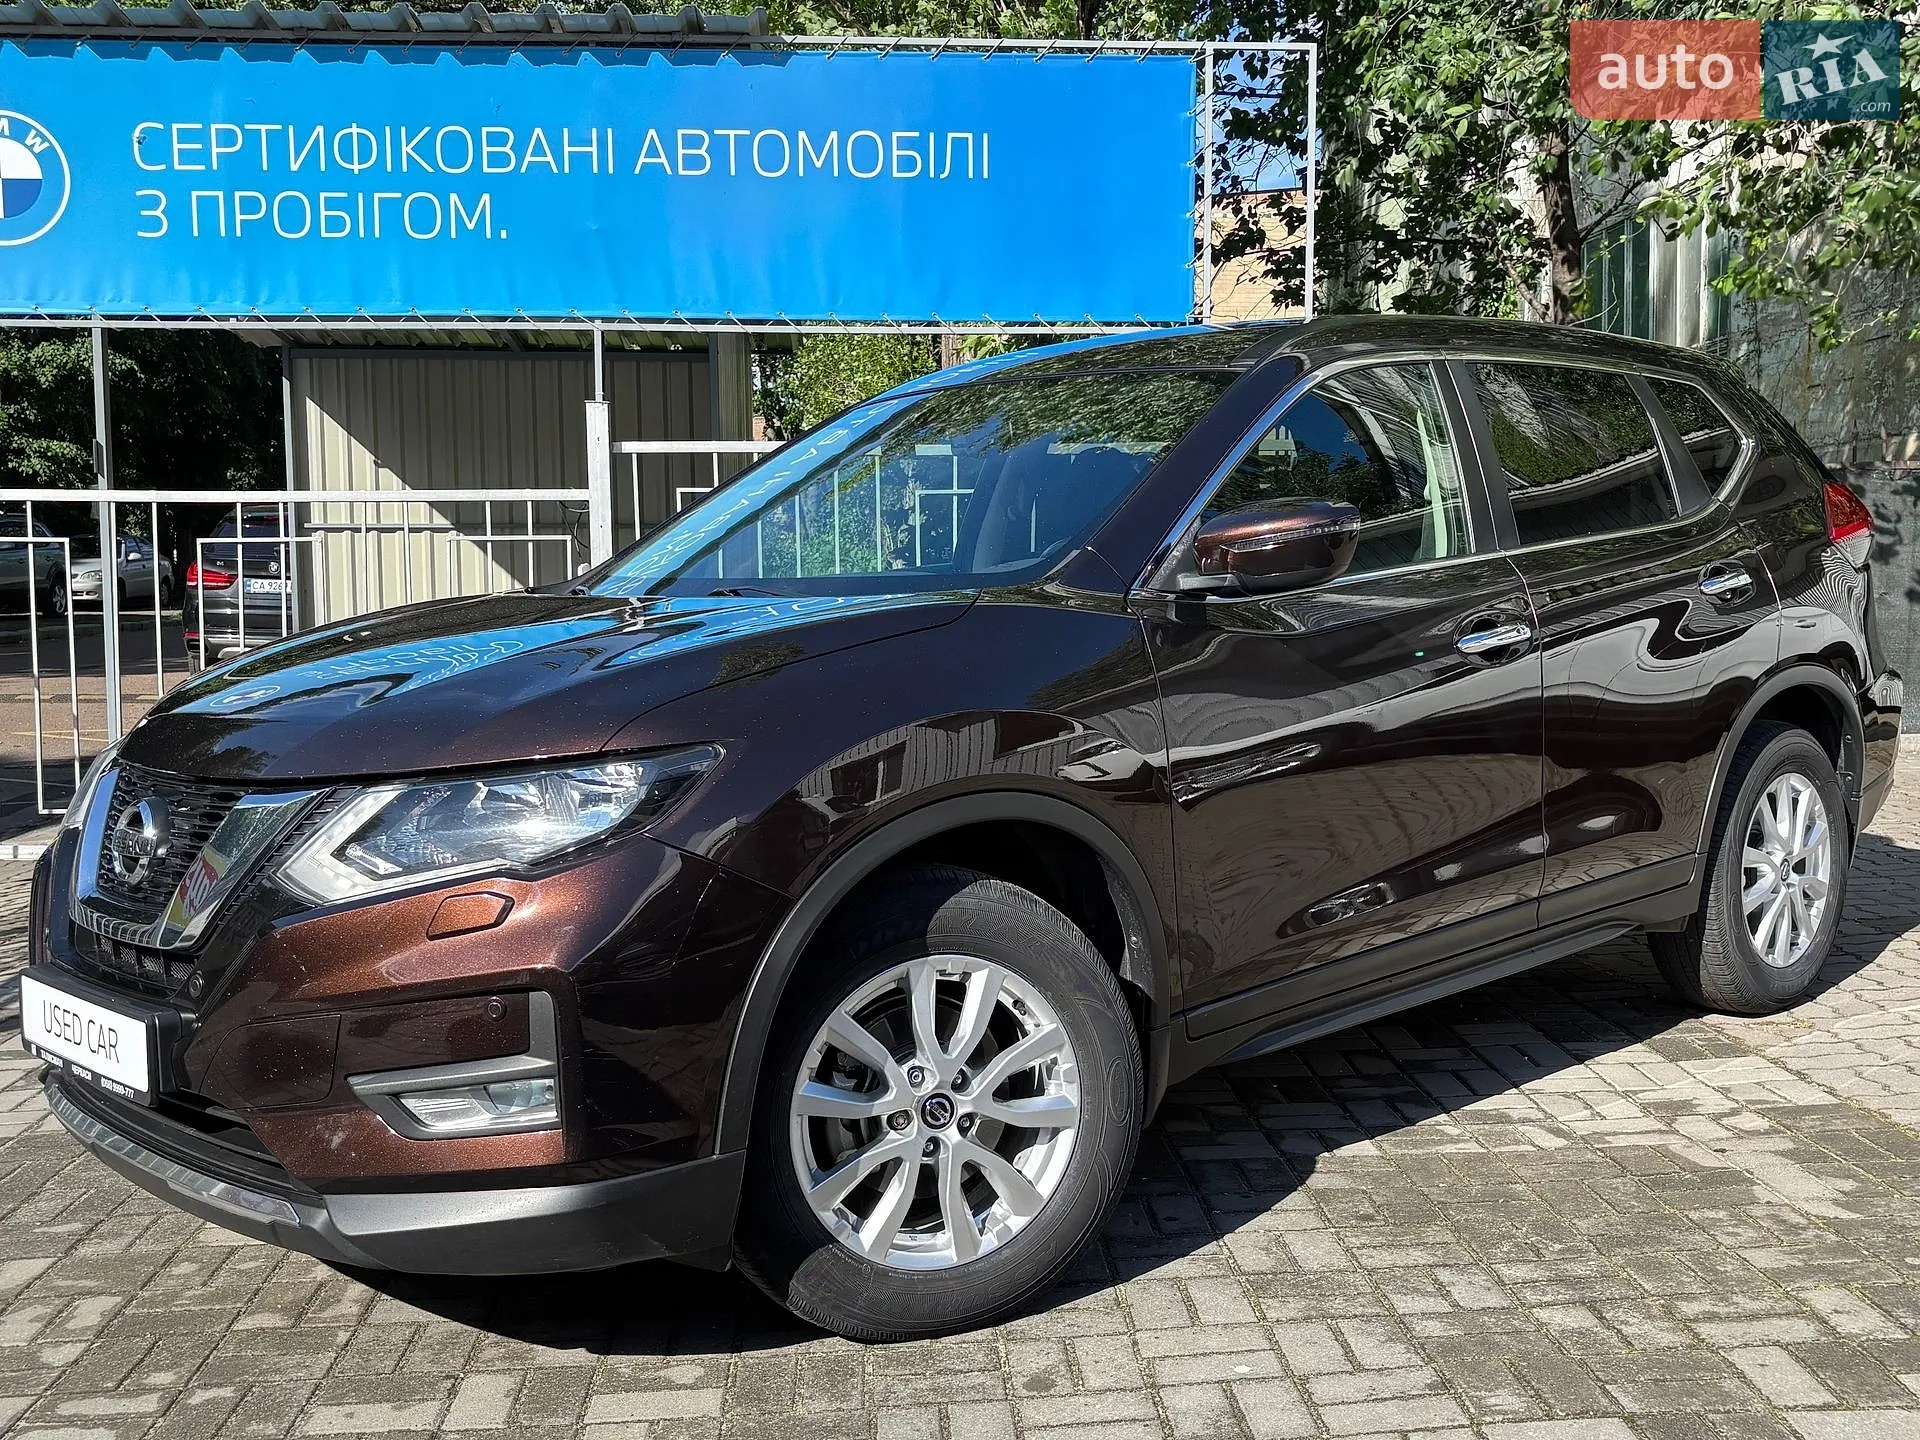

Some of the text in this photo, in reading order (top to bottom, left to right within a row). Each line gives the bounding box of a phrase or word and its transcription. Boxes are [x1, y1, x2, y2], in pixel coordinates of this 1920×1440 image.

[133, 121, 990, 179] СЕРТИФІКОВАНІ АВТОМОБІЛІ
[135, 189, 508, 240] З ПРОБІГОМ.
[43, 999, 82, 1046] USED
[87, 1019, 119, 1064] CAR
